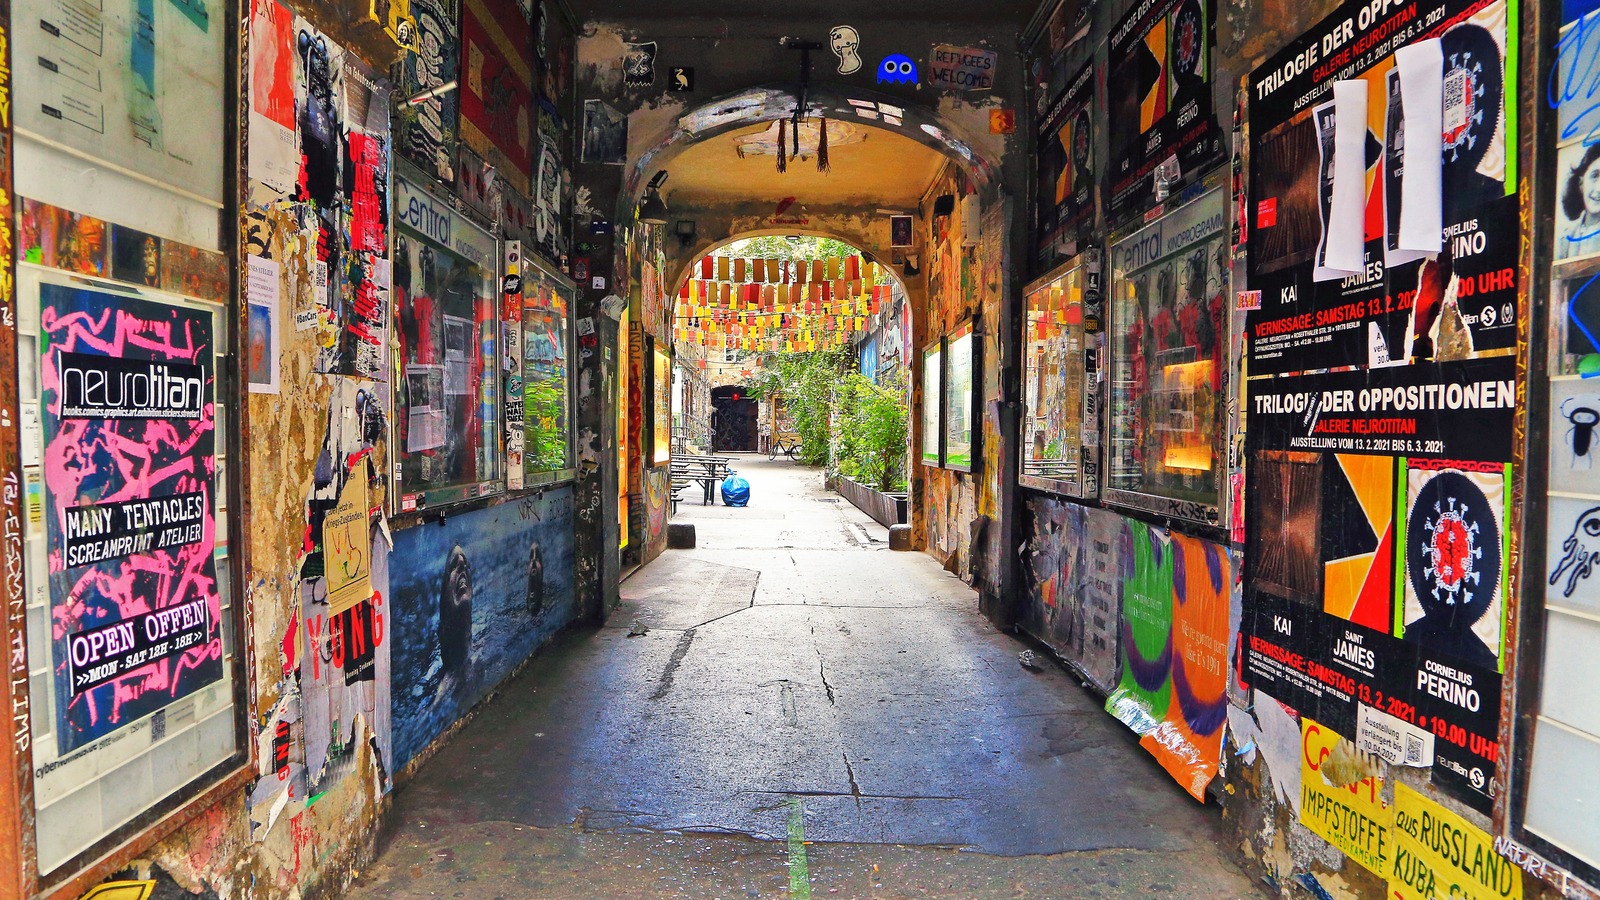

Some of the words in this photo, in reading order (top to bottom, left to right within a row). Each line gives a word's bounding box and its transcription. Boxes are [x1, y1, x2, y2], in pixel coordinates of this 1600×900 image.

[936, 50, 991, 70] REFUGEES
[1257, 42, 1318, 100] TRILOGIE
[1323, 18, 1354, 57] DER
[1358, 0, 1403, 30] OPP
[1293, 75, 1338, 111] AUSSTELLUNG
[1338, 64, 1355, 82] VOM
[1355, 58, 1366, 71] 13.
[1366, 52, 1374, 64] 2.
[1374, 40, 1391, 60] 2021
[1392, 30, 1406, 47] BIS
[1407, 25, 1415, 38] 6.
[1416, 20, 1424, 33] 3.
[1425, 4, 1446, 26] 2021
[1312, 48, 1351, 83] GALERIE
[1352, 2, 1417, 57] NEUROTITAN
[932, 67, 991, 88] WELCOME
[398, 176, 451, 247] Central
[1443, 218, 1479, 241] RNELIUS
[1114, 221, 1163, 273] Central
[1281, 284, 1298, 304] KAI
[1478, 267, 1515, 294] UHR
[296, 311, 317, 324] #BanCars
[1255, 313, 1315, 337] VERNISSAGE:
[1316, 300, 1365, 326] SAMSTAG
[1367, 297, 1383, 317] 13.
[1385, 294, 1395, 313] 2.
[63, 364, 201, 409] neurotitan
[1255, 392, 1313, 414] TRILOGI
[1322, 389, 1354, 412] DER
[1358, 380, 1515, 412] OPPOSITIONEN
[1352, 418, 1416, 434] NEUROTITAN
[1290, 437, 1337, 449] AUSSTELLUNG
[1338, 438, 1353, 449] VOM
[1355, 438, 1365, 450] 13.
[1366, 439, 1372, 450] 2.
[1373, 439, 1390, 451] 2021
[1392, 439, 1405, 452] BIS
[1407, 440, 1414, 452] 6.
[1416, 440, 1423, 452] 3.
[1425, 440, 1444, 453] 2021
[67, 507, 112, 540] MANY
[123, 495, 203, 530] TENTACLES
[68, 532, 154, 567] SCREAMPRINT
[158, 523, 201, 547] ATELIER
[72, 621, 136, 667] OPEN
[145, 599, 206, 642] OFFEN
[1273, 615, 1292, 637] KAI
[1345, 630, 1364, 645] SAINT
[125, 649, 148, 669] SAT
[148, 641, 169, 660] 12H
[174, 631, 193, 651] 18H
[1333, 638, 1375, 670] JAMES
[1249, 634, 1306, 673] VERNISSAGE:
[1307, 660, 1356, 696] SAMSTAG
[1358, 682, 1373, 705] 13.
[1375, 690, 1386, 711] 2.
[1387, 696, 1416, 724] 2021
[1430, 715, 1467, 748] 19.00
[1417, 669, 1481, 713] PERINO
[1425, 659, 1473, 687] CORNELIUS
[1361, 727, 1392, 750] verlängert
[1392, 741, 1403, 753] bis
[1364, 716, 1400, 740] Ausstellung
[1364, 740, 1397, 763] 30.04.2021
[1303, 784, 1387, 861] IMPFSTOFFE
[1334, 832, 1384, 874] MEDIKAMENTE
[1393, 844, 1437, 899] KUBA
